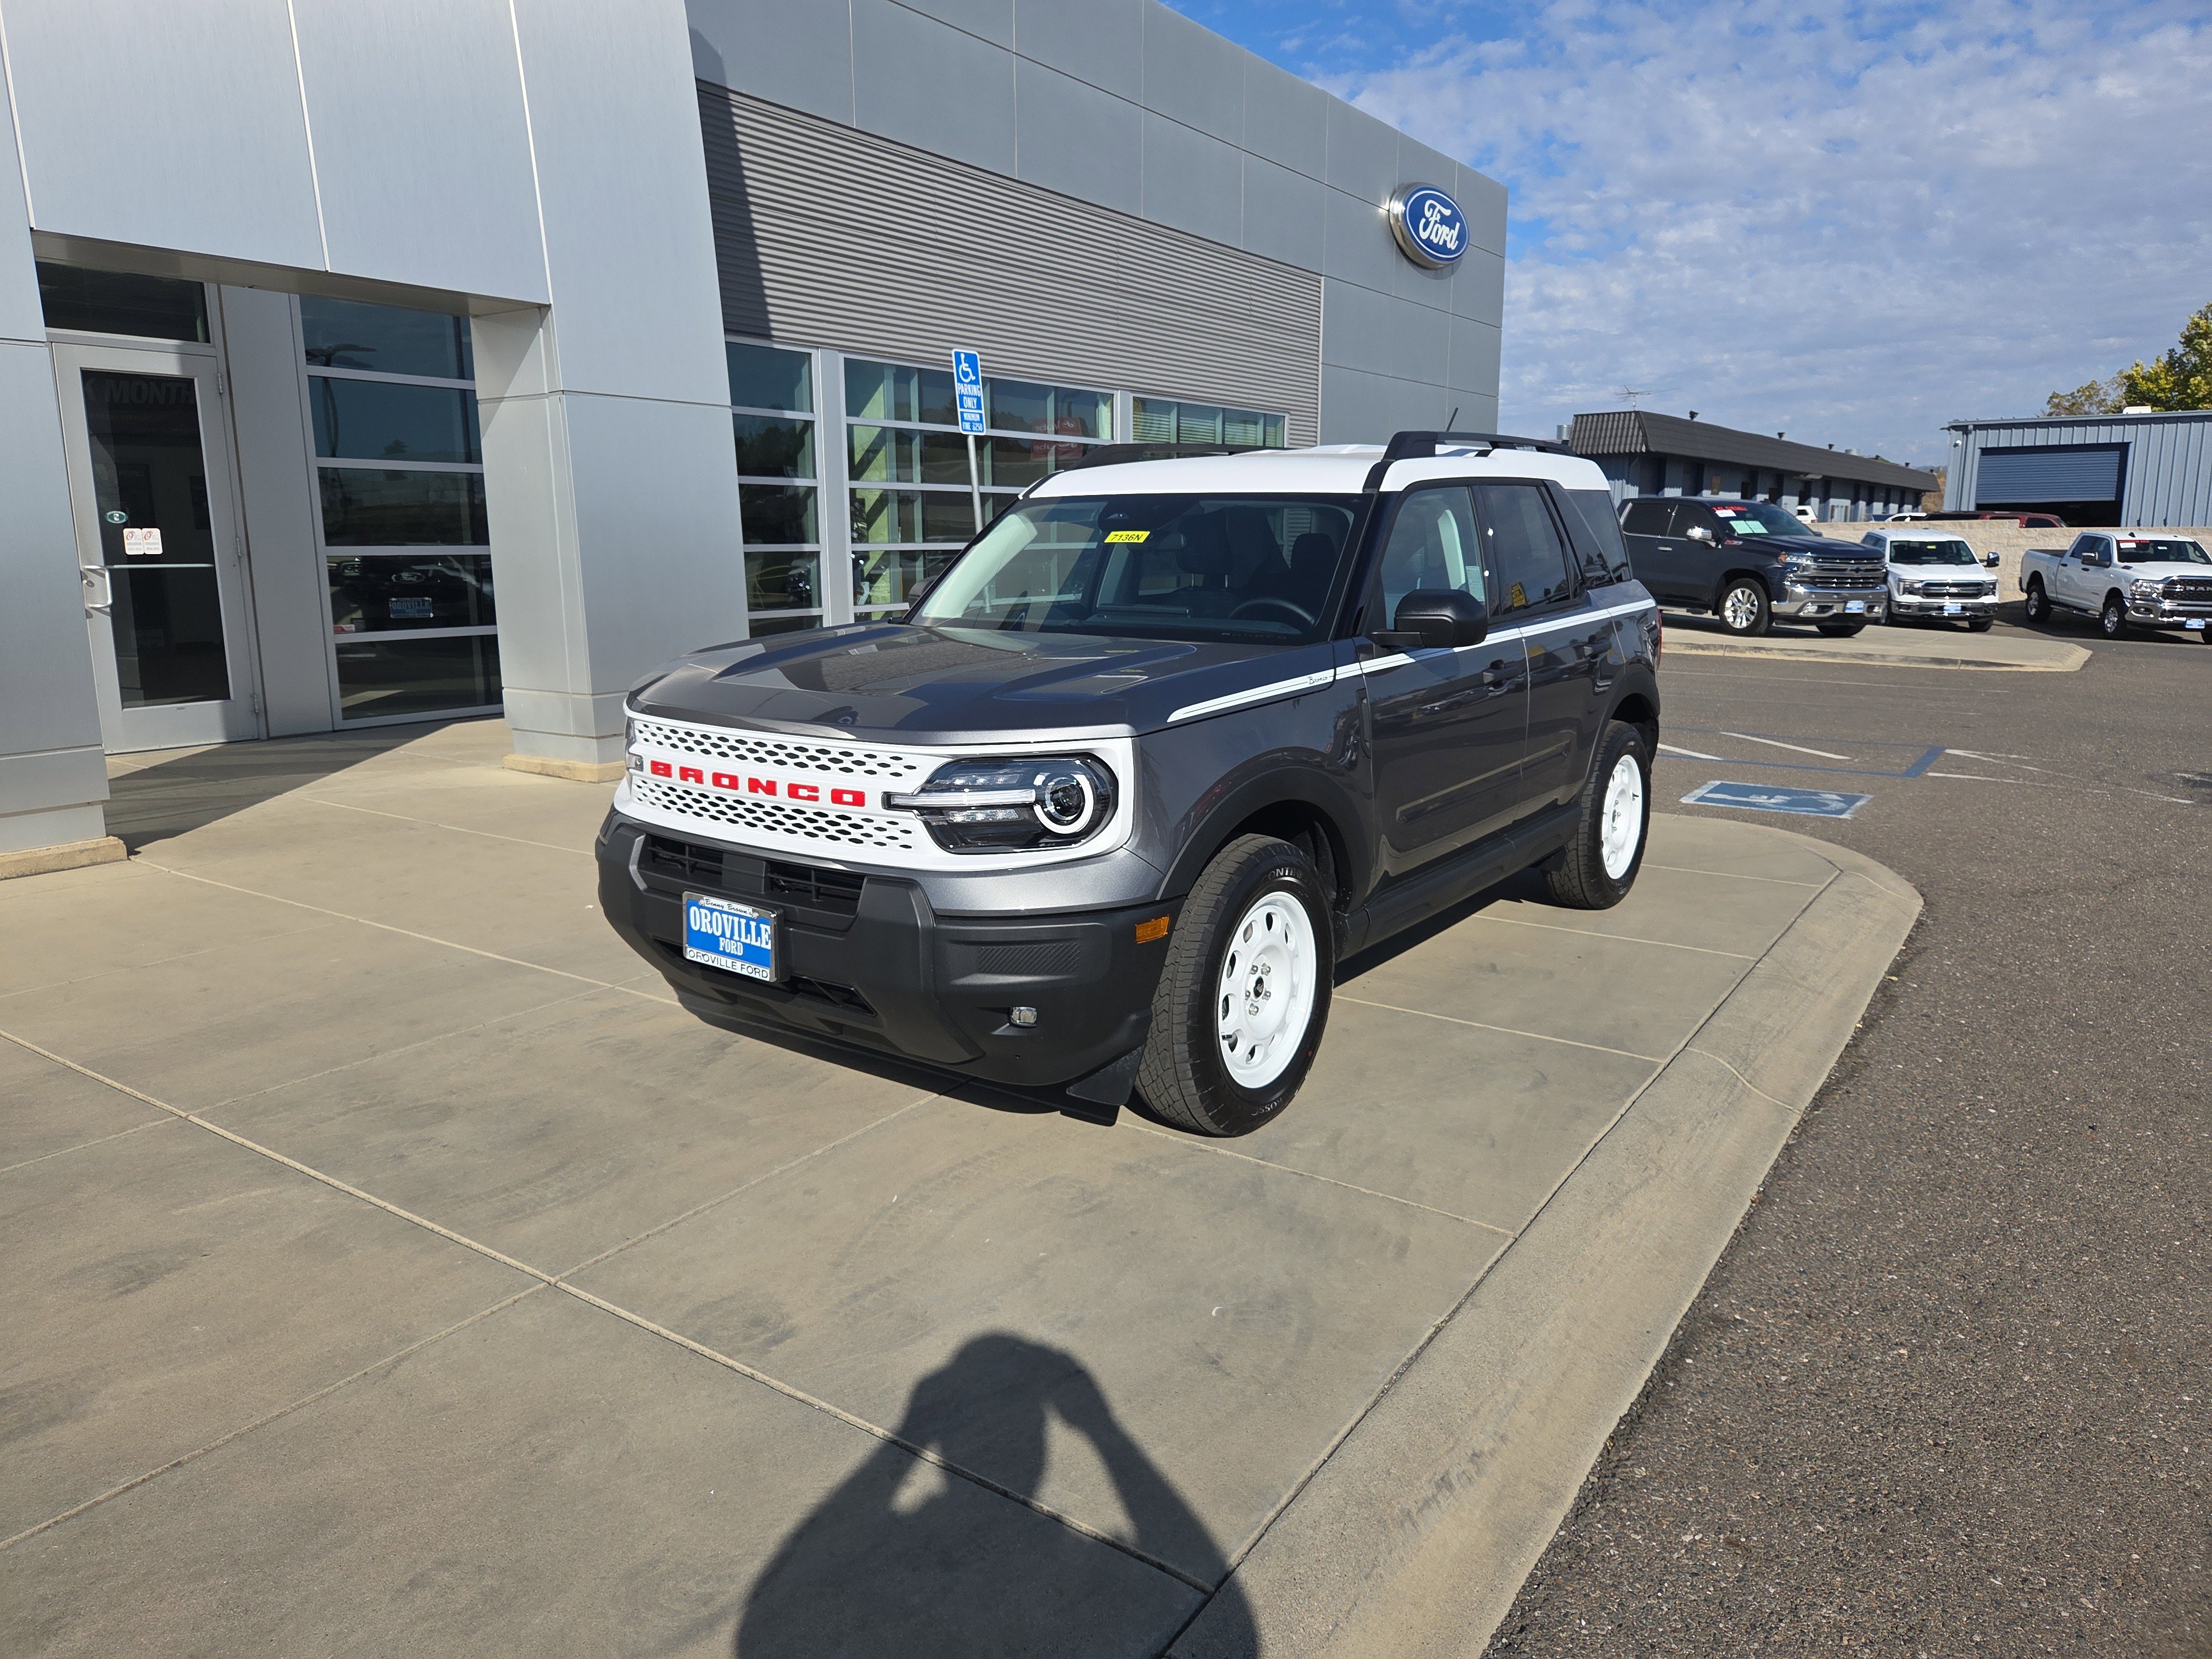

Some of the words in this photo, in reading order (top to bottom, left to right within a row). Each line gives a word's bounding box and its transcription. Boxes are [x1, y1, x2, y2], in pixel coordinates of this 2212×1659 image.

[1419, 200, 1460, 250] Ford
[957, 383, 981, 397] PARKING
[963, 397, 977, 409] ONLY
[651, 760, 866, 807] BRONCO
[705, 898, 724, 910] Benny
[689, 906, 771, 949] OROVILLE
[719, 937, 743, 956] FORD
[689, 949, 737, 970] OROVILLE
[741, 963, 768, 979] FORD
